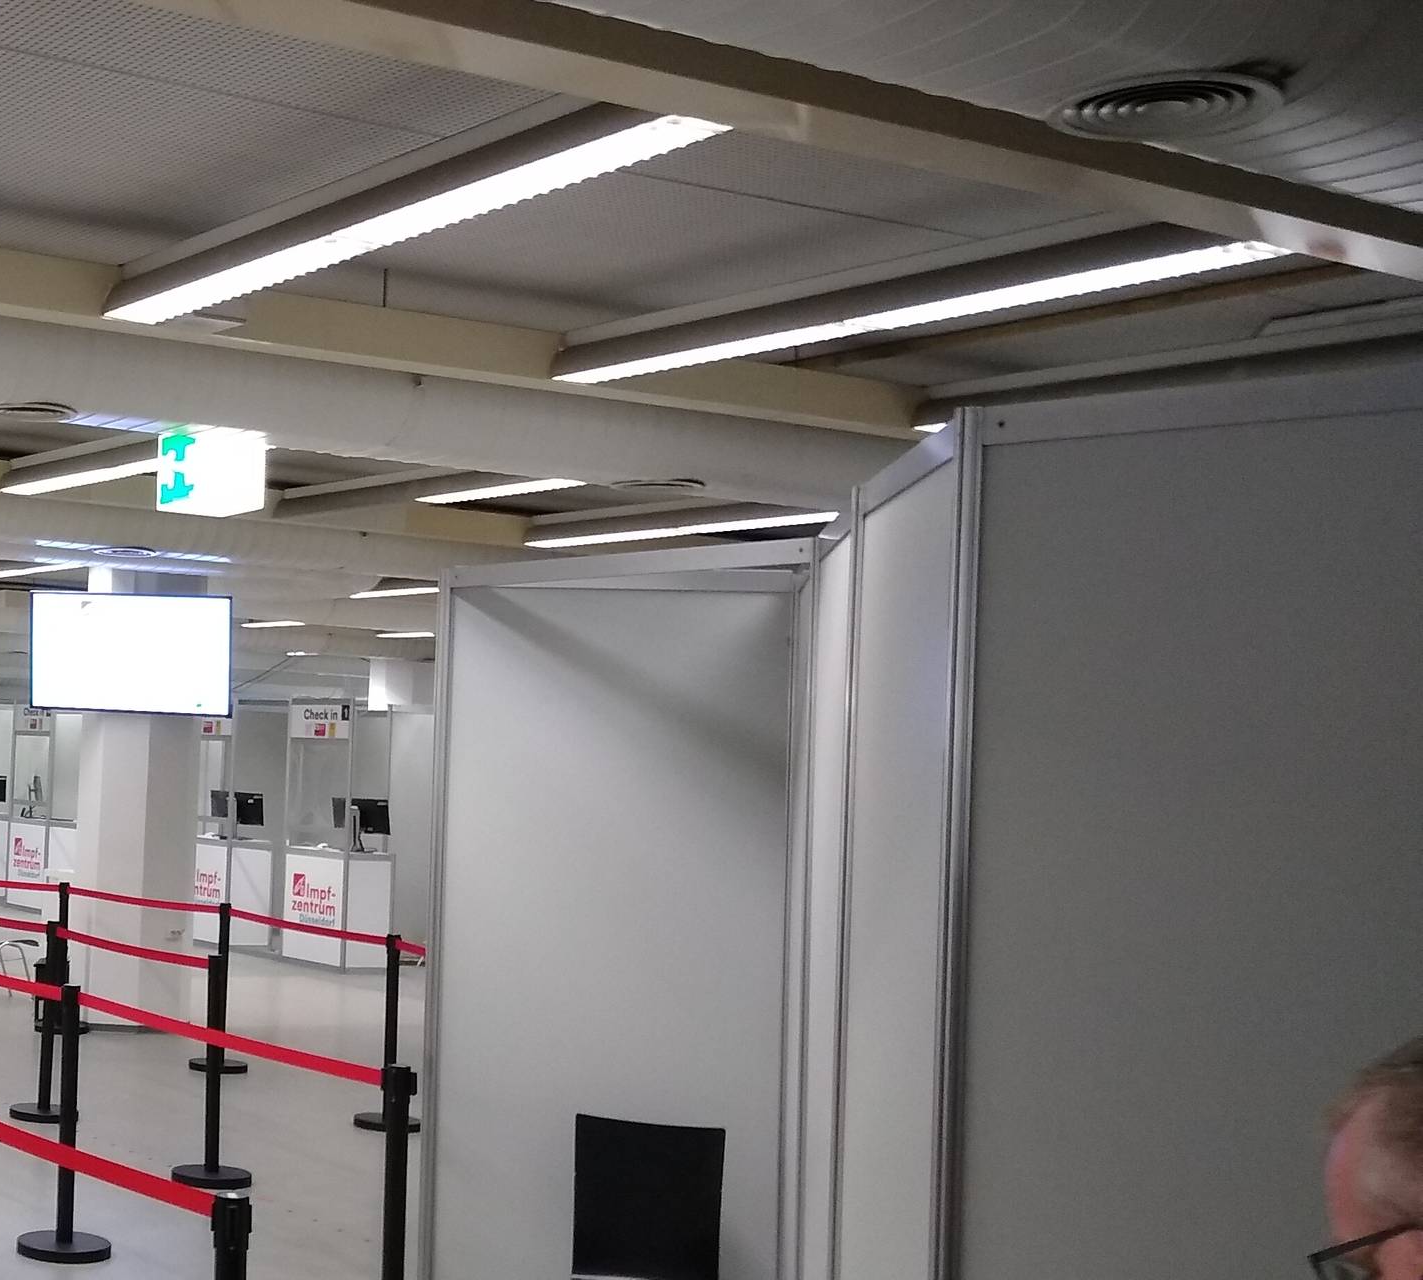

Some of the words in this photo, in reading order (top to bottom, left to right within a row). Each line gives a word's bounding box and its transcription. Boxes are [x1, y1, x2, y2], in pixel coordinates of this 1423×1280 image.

[304, 708, 328, 720] Check
[330, 709, 338, 720] in
[196, 868, 221, 885] Impf-
[194, 885, 220, 898] ntrum
[307, 883, 336, 901] Impf-
[292, 899, 335, 916] zentrum
